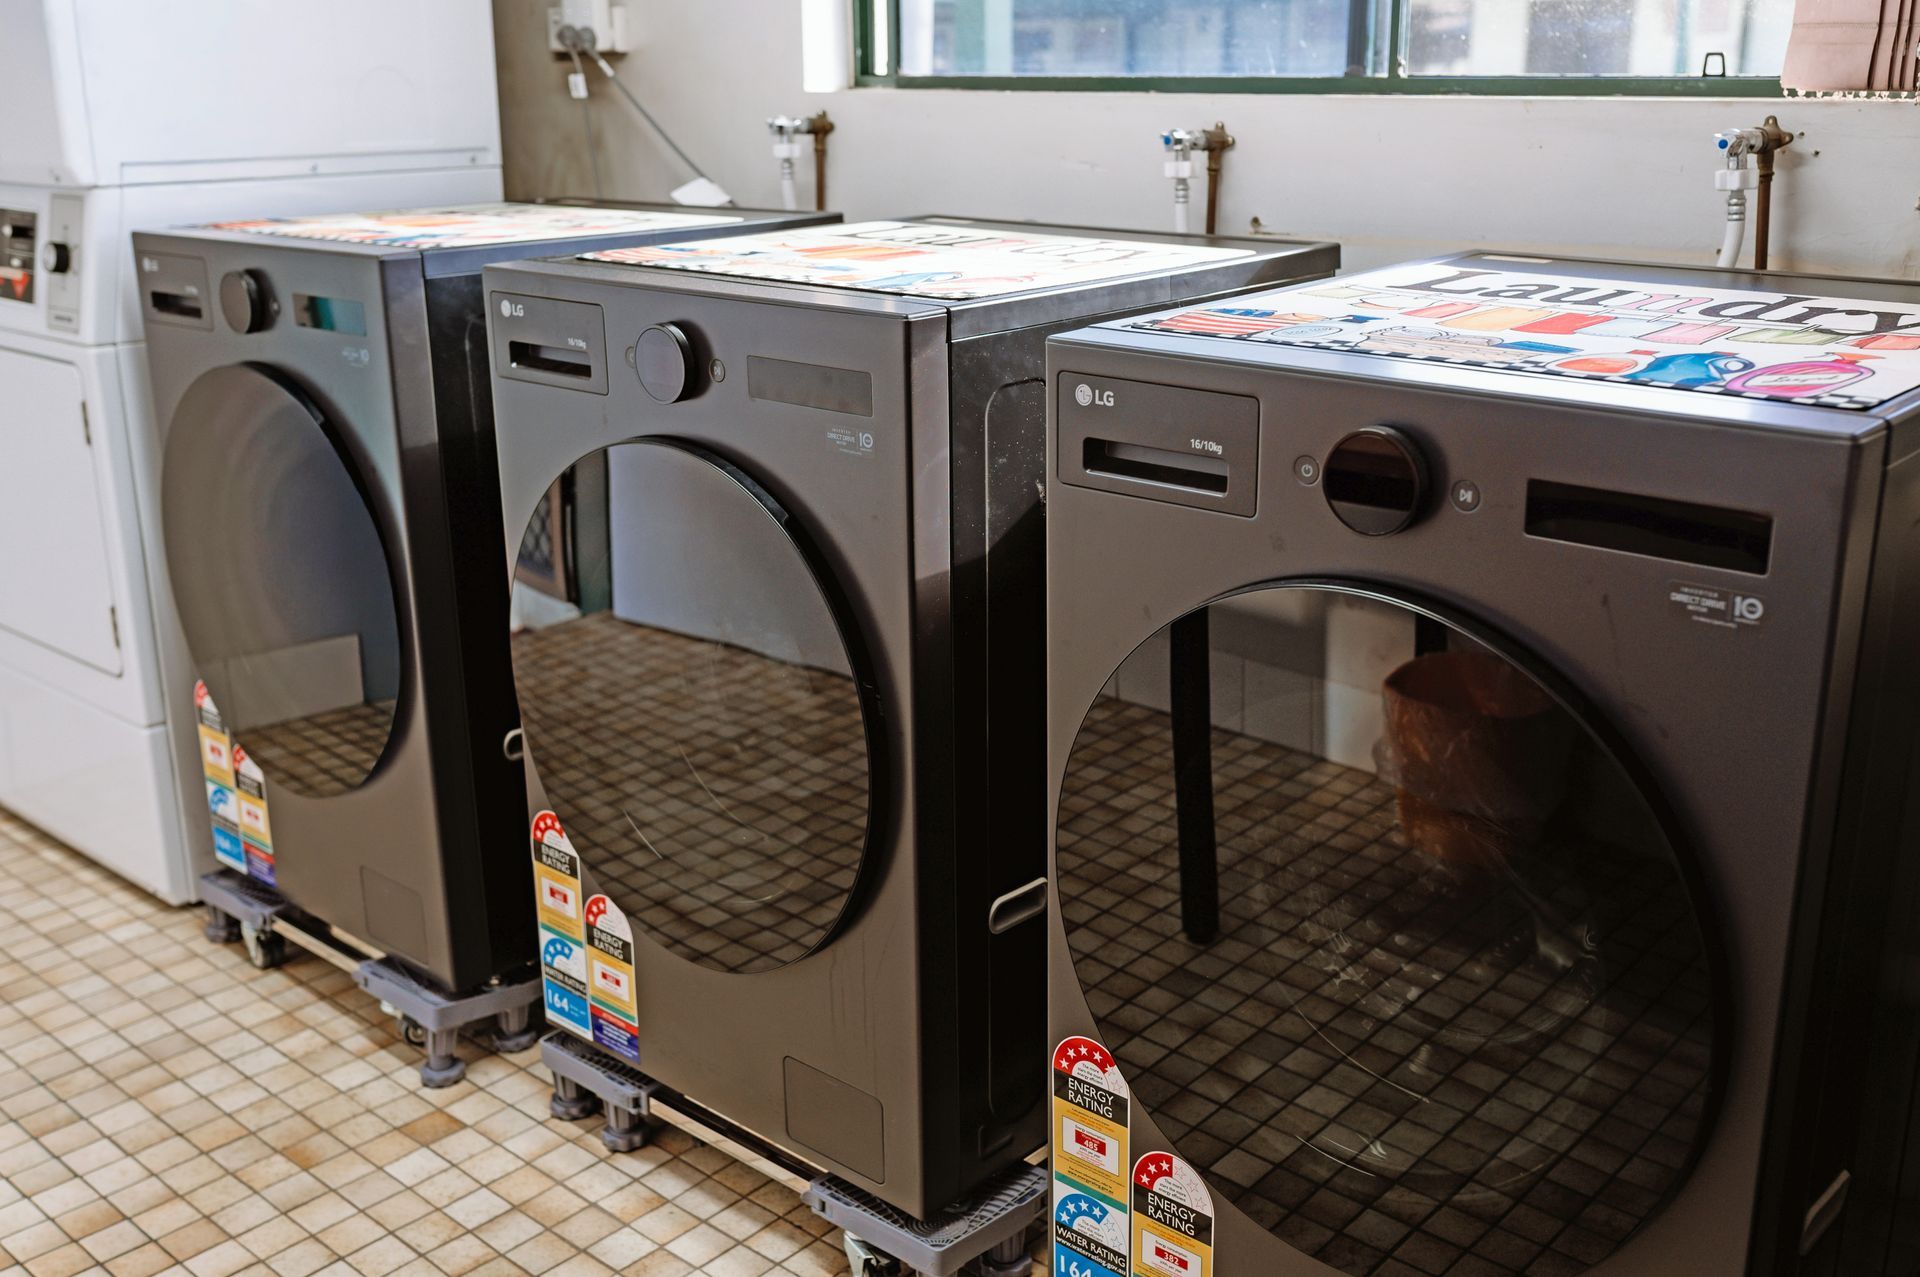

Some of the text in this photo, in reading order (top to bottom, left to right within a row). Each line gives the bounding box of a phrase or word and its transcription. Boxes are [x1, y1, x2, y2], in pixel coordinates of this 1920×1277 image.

[512, 303, 524, 317] LG
[1386, 271, 1920, 336] Laundry
[1095, 389, 1114, 407] LG
[1190, 439, 1223, 454] 16/10kg
[1734, 596, 1764, 620] 10
[541, 844, 570, 865] ENERGY
[542, 854, 570, 875] RATING
[593, 927, 623, 949] ENERGY
[594, 938, 623, 960] RATING
[547, 989, 569, 1012] 164
[1068, 1077, 1114, 1106] ENERGY
[1068, 1090, 1113, 1118] RATING
[1083, 1140, 1099, 1152] 485
[1148, 1192, 1196, 1222] ENERGY
[1148, 1205, 1195, 1236] RATING
[1056, 1225, 1126, 1268] WATER RATING
[1163, 1252, 1180, 1265] 382
